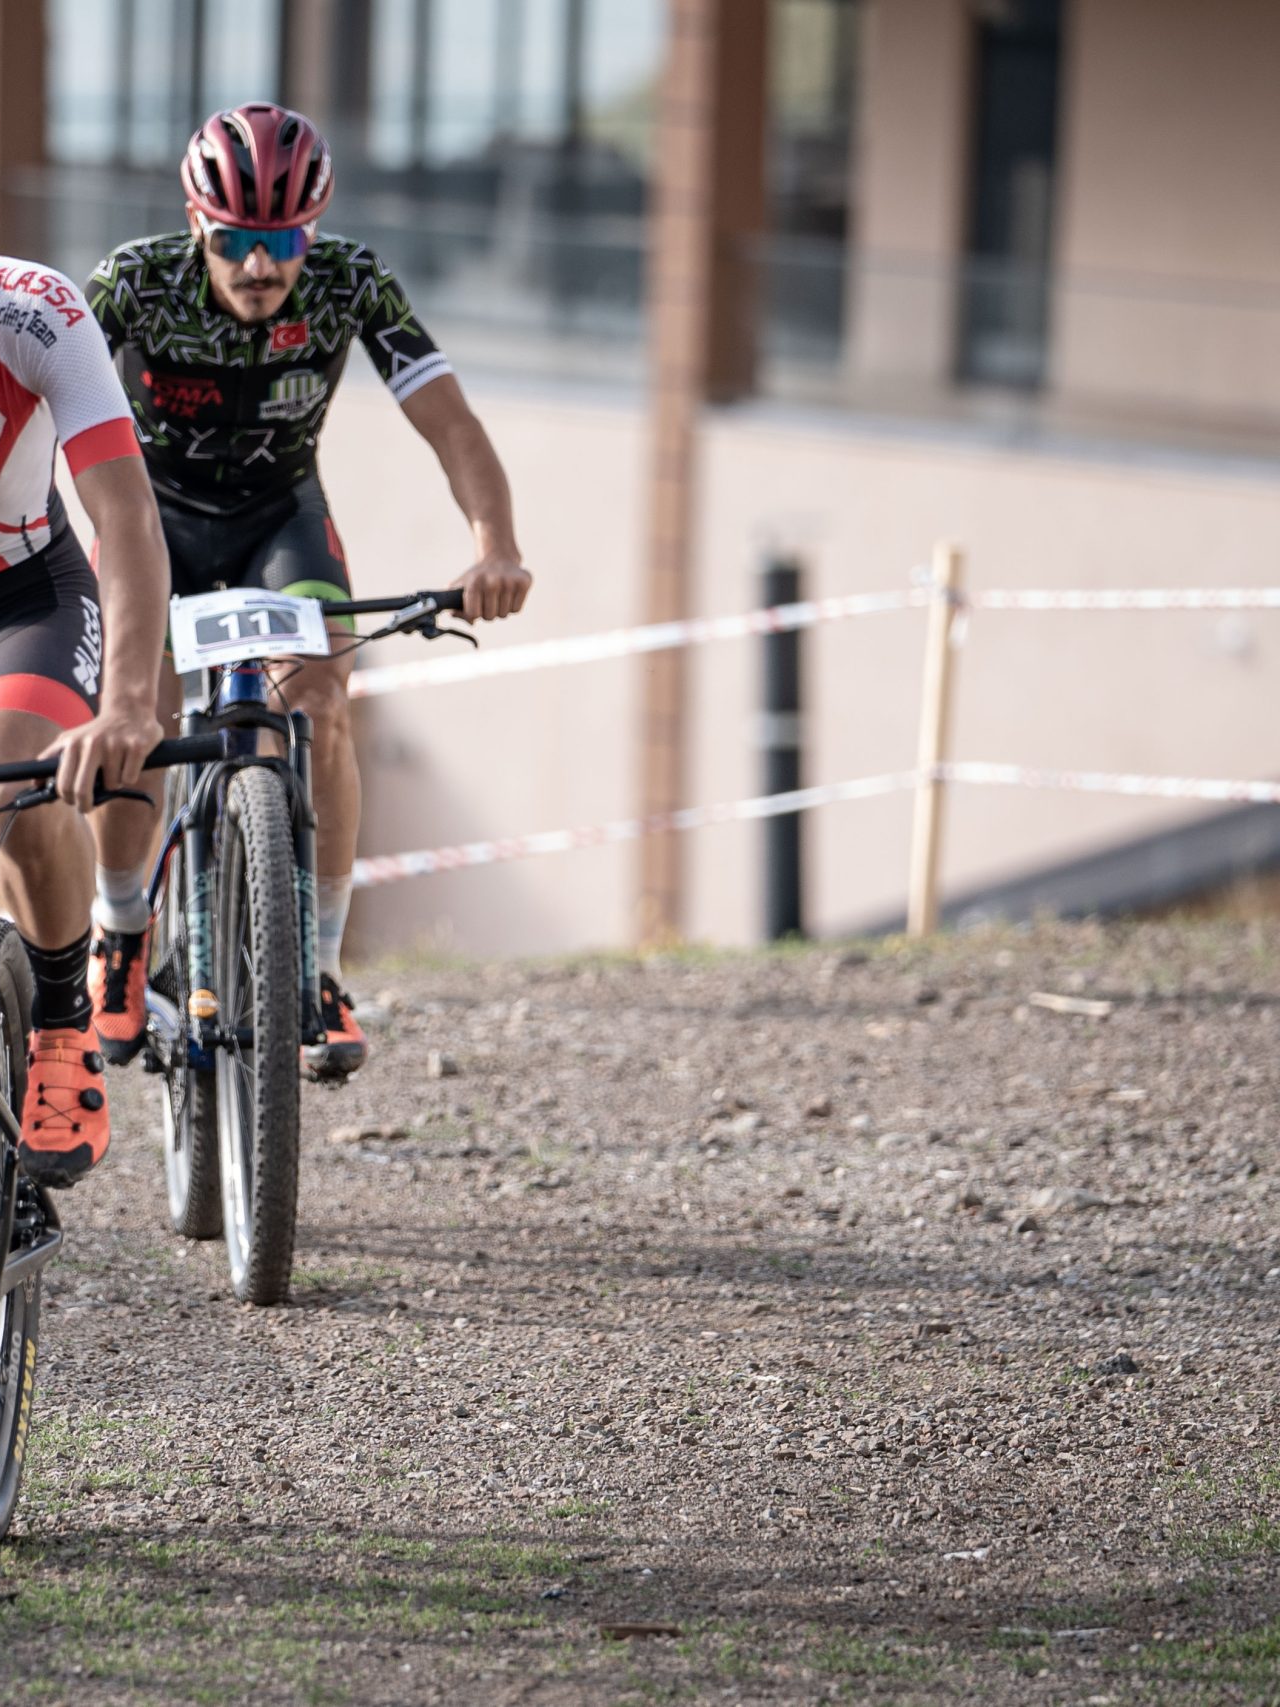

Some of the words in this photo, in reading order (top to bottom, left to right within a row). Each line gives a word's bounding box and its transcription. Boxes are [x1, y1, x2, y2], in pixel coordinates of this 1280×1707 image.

[2, 267, 86, 328] LASSA
[26, 309, 58, 349] Team
[217, 609, 271, 640] 11
[187, 911, 212, 978] FOX
[14, 1337, 36, 1464] MAXXIS
